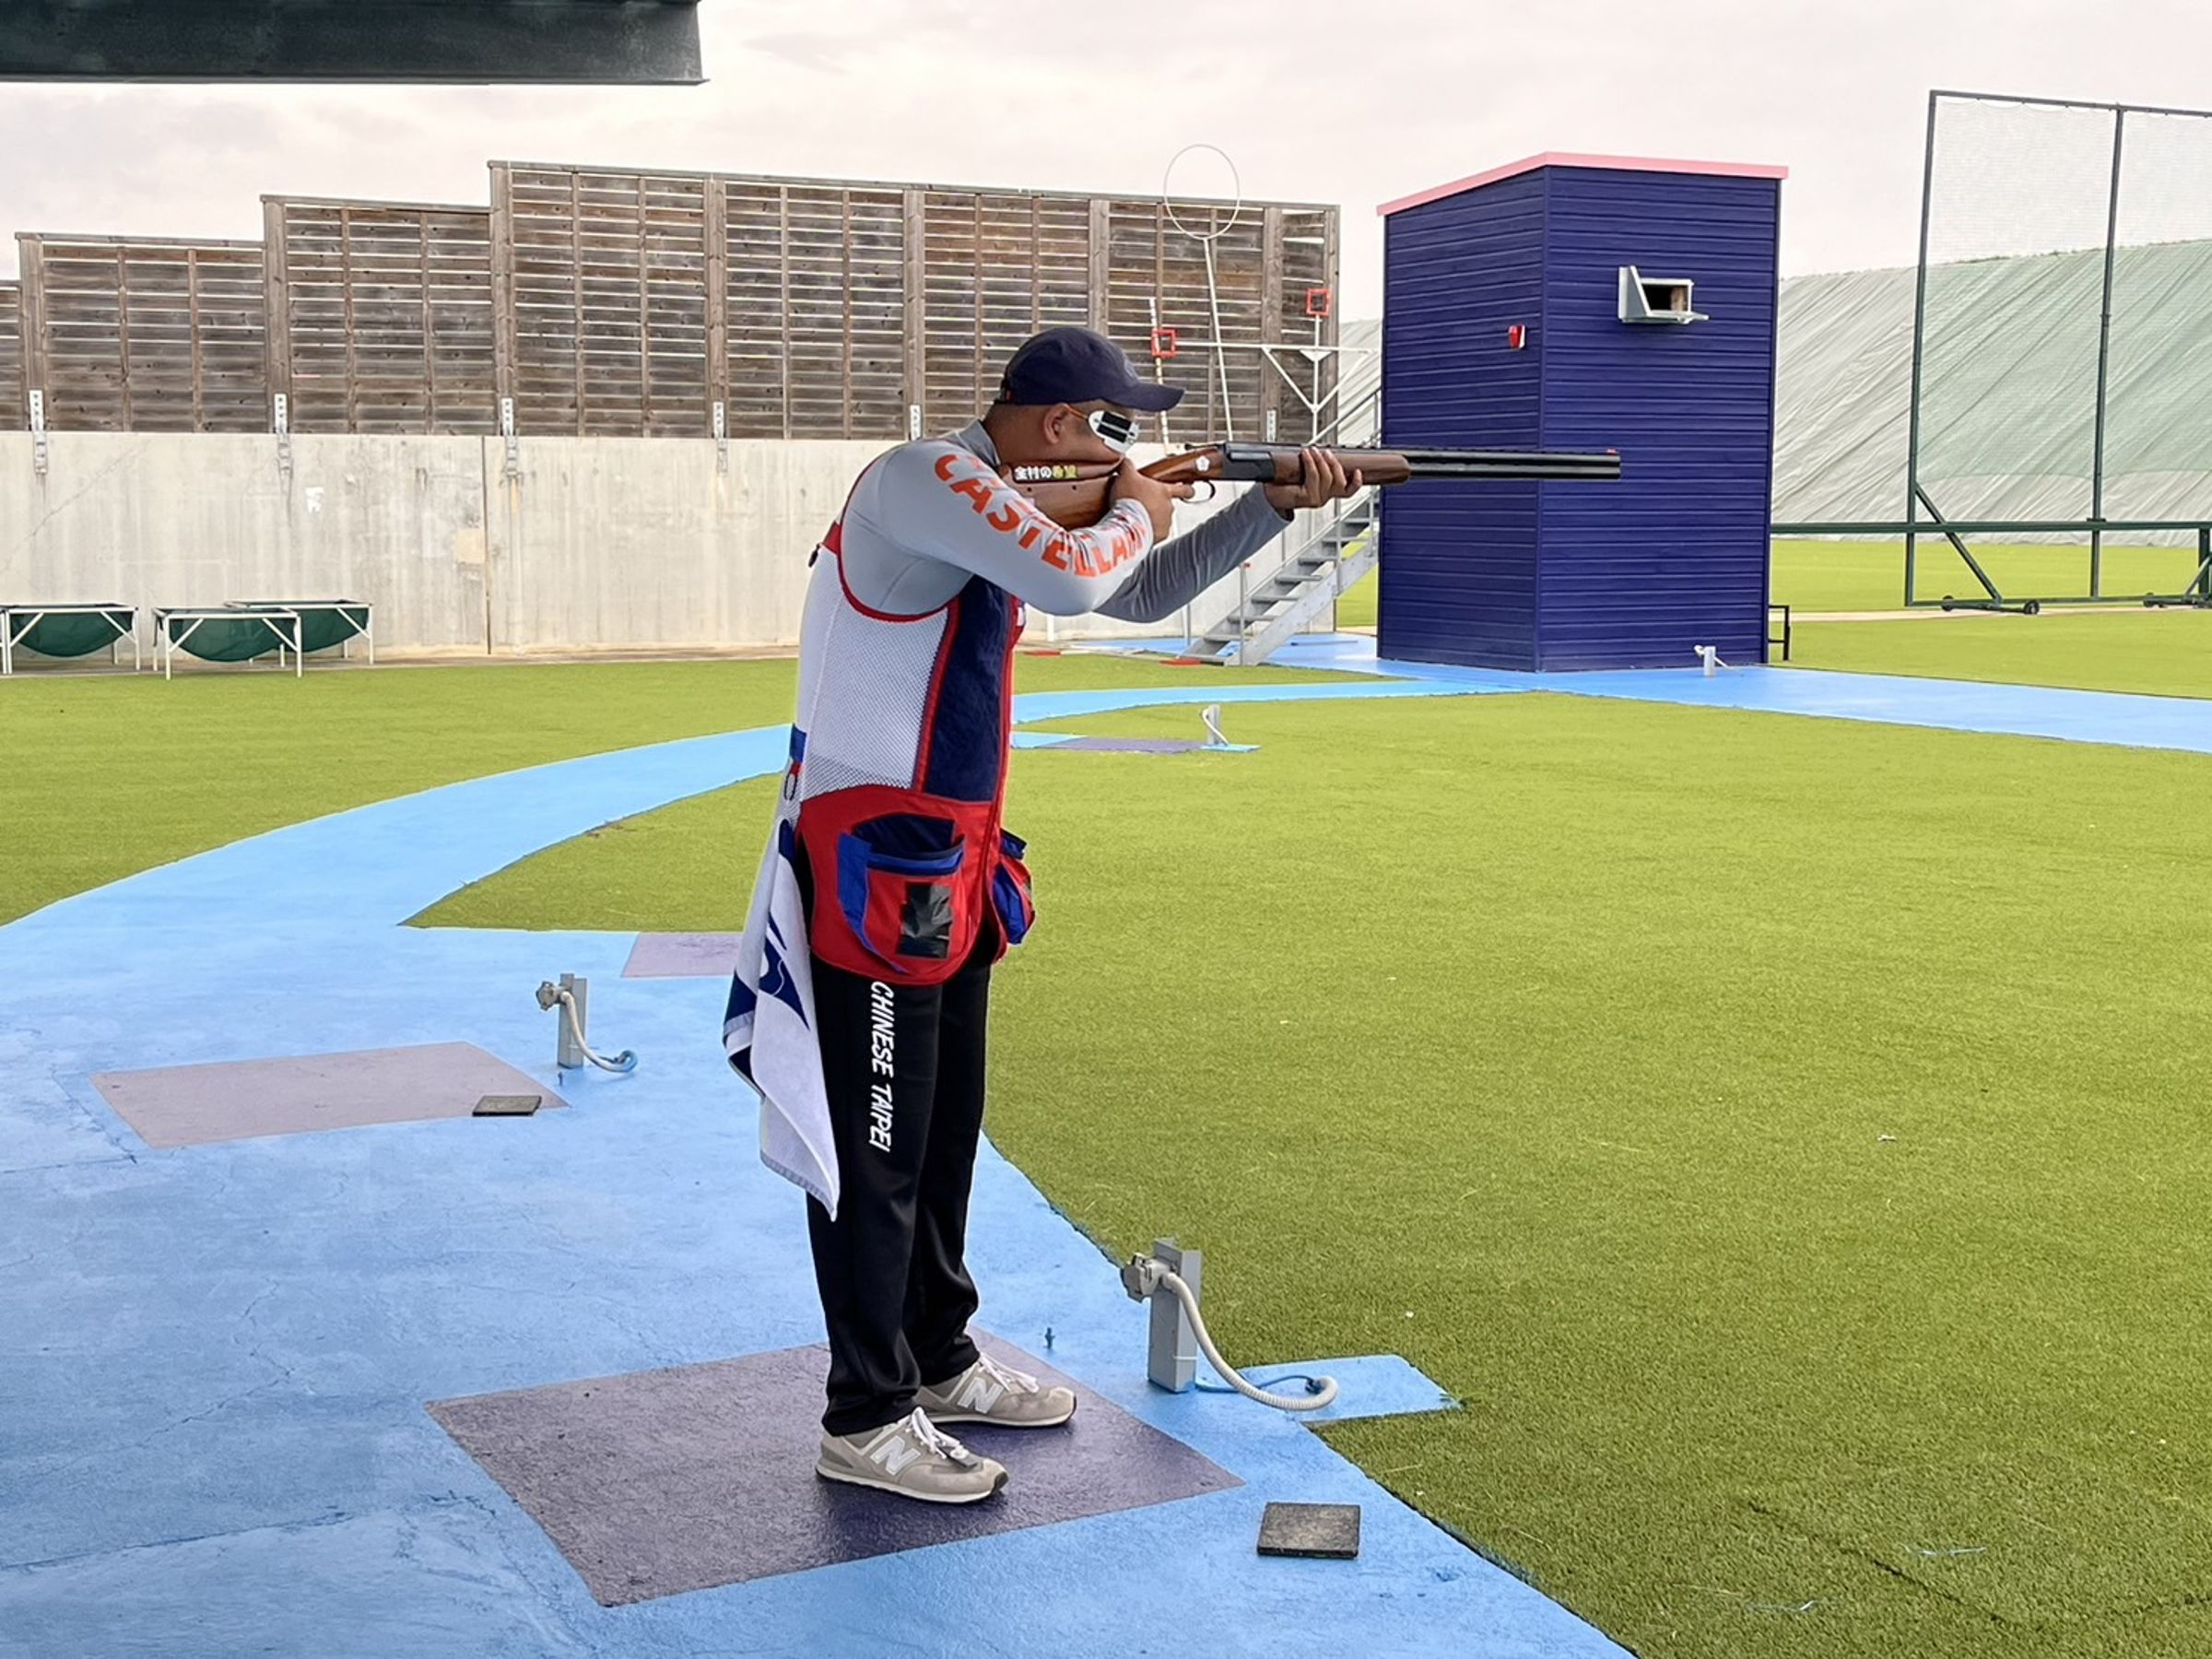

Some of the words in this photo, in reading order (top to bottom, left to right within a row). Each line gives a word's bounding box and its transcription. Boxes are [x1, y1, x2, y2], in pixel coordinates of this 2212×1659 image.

[871, 981, 895, 1077] CHINESE
[868, 1083, 893, 1152] TAIPEI
[957, 1377, 1006, 1414] N
[869, 1435, 921, 1475] N
